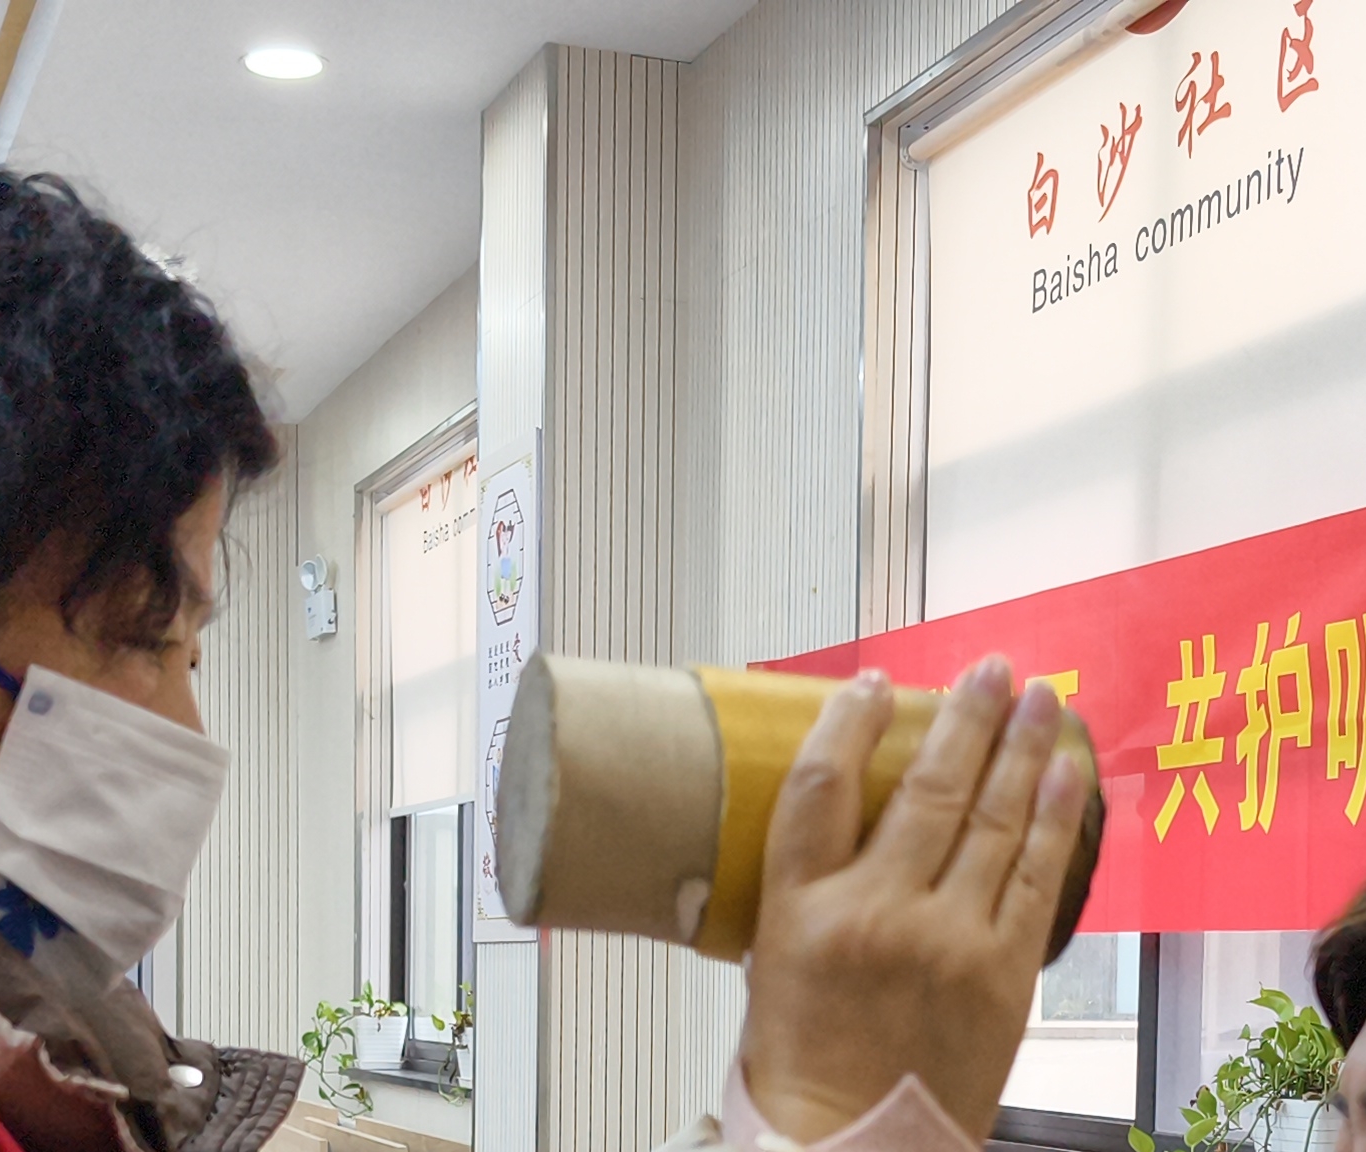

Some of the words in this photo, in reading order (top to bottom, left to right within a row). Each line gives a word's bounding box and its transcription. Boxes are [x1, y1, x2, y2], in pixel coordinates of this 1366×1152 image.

[1028, 0, 1319, 239] 白沙社区
[1032, 243, 1119, 314] Baisha
[1135, 147, 1305, 262] community
